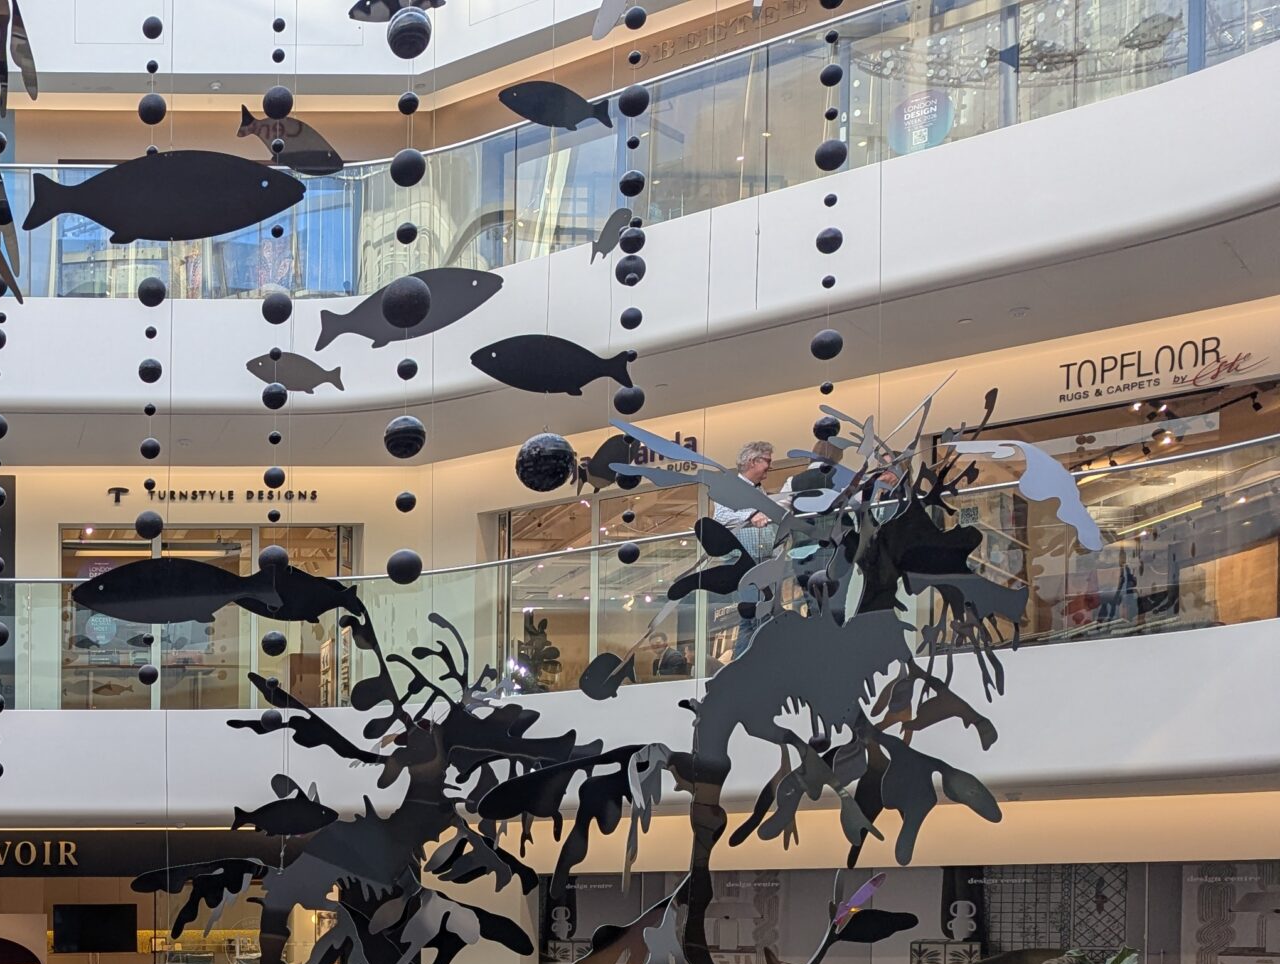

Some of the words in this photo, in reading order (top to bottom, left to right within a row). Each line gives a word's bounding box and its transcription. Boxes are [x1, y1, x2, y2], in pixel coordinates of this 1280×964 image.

[904, 99, 937, 113] LONDON
[904, 106, 937, 120] DESIGN
[1059, 336, 1221, 390] TOPFLOOR
[1059, 390, 1090, 403] RUGS
[1094, 388, 1103, 397] &
[1107, 378, 1161, 394] CARPETS
[1173, 374, 1189, 385] by
[149, 490, 235, 500] TURNSTYLE
[246, 490, 318, 500] DESIGNS
[726, 880, 752, 889] design
[968, 877, 998, 886] design
[1186, 875, 1221, 885] design
[1223, 875, 1262, 883] centre
